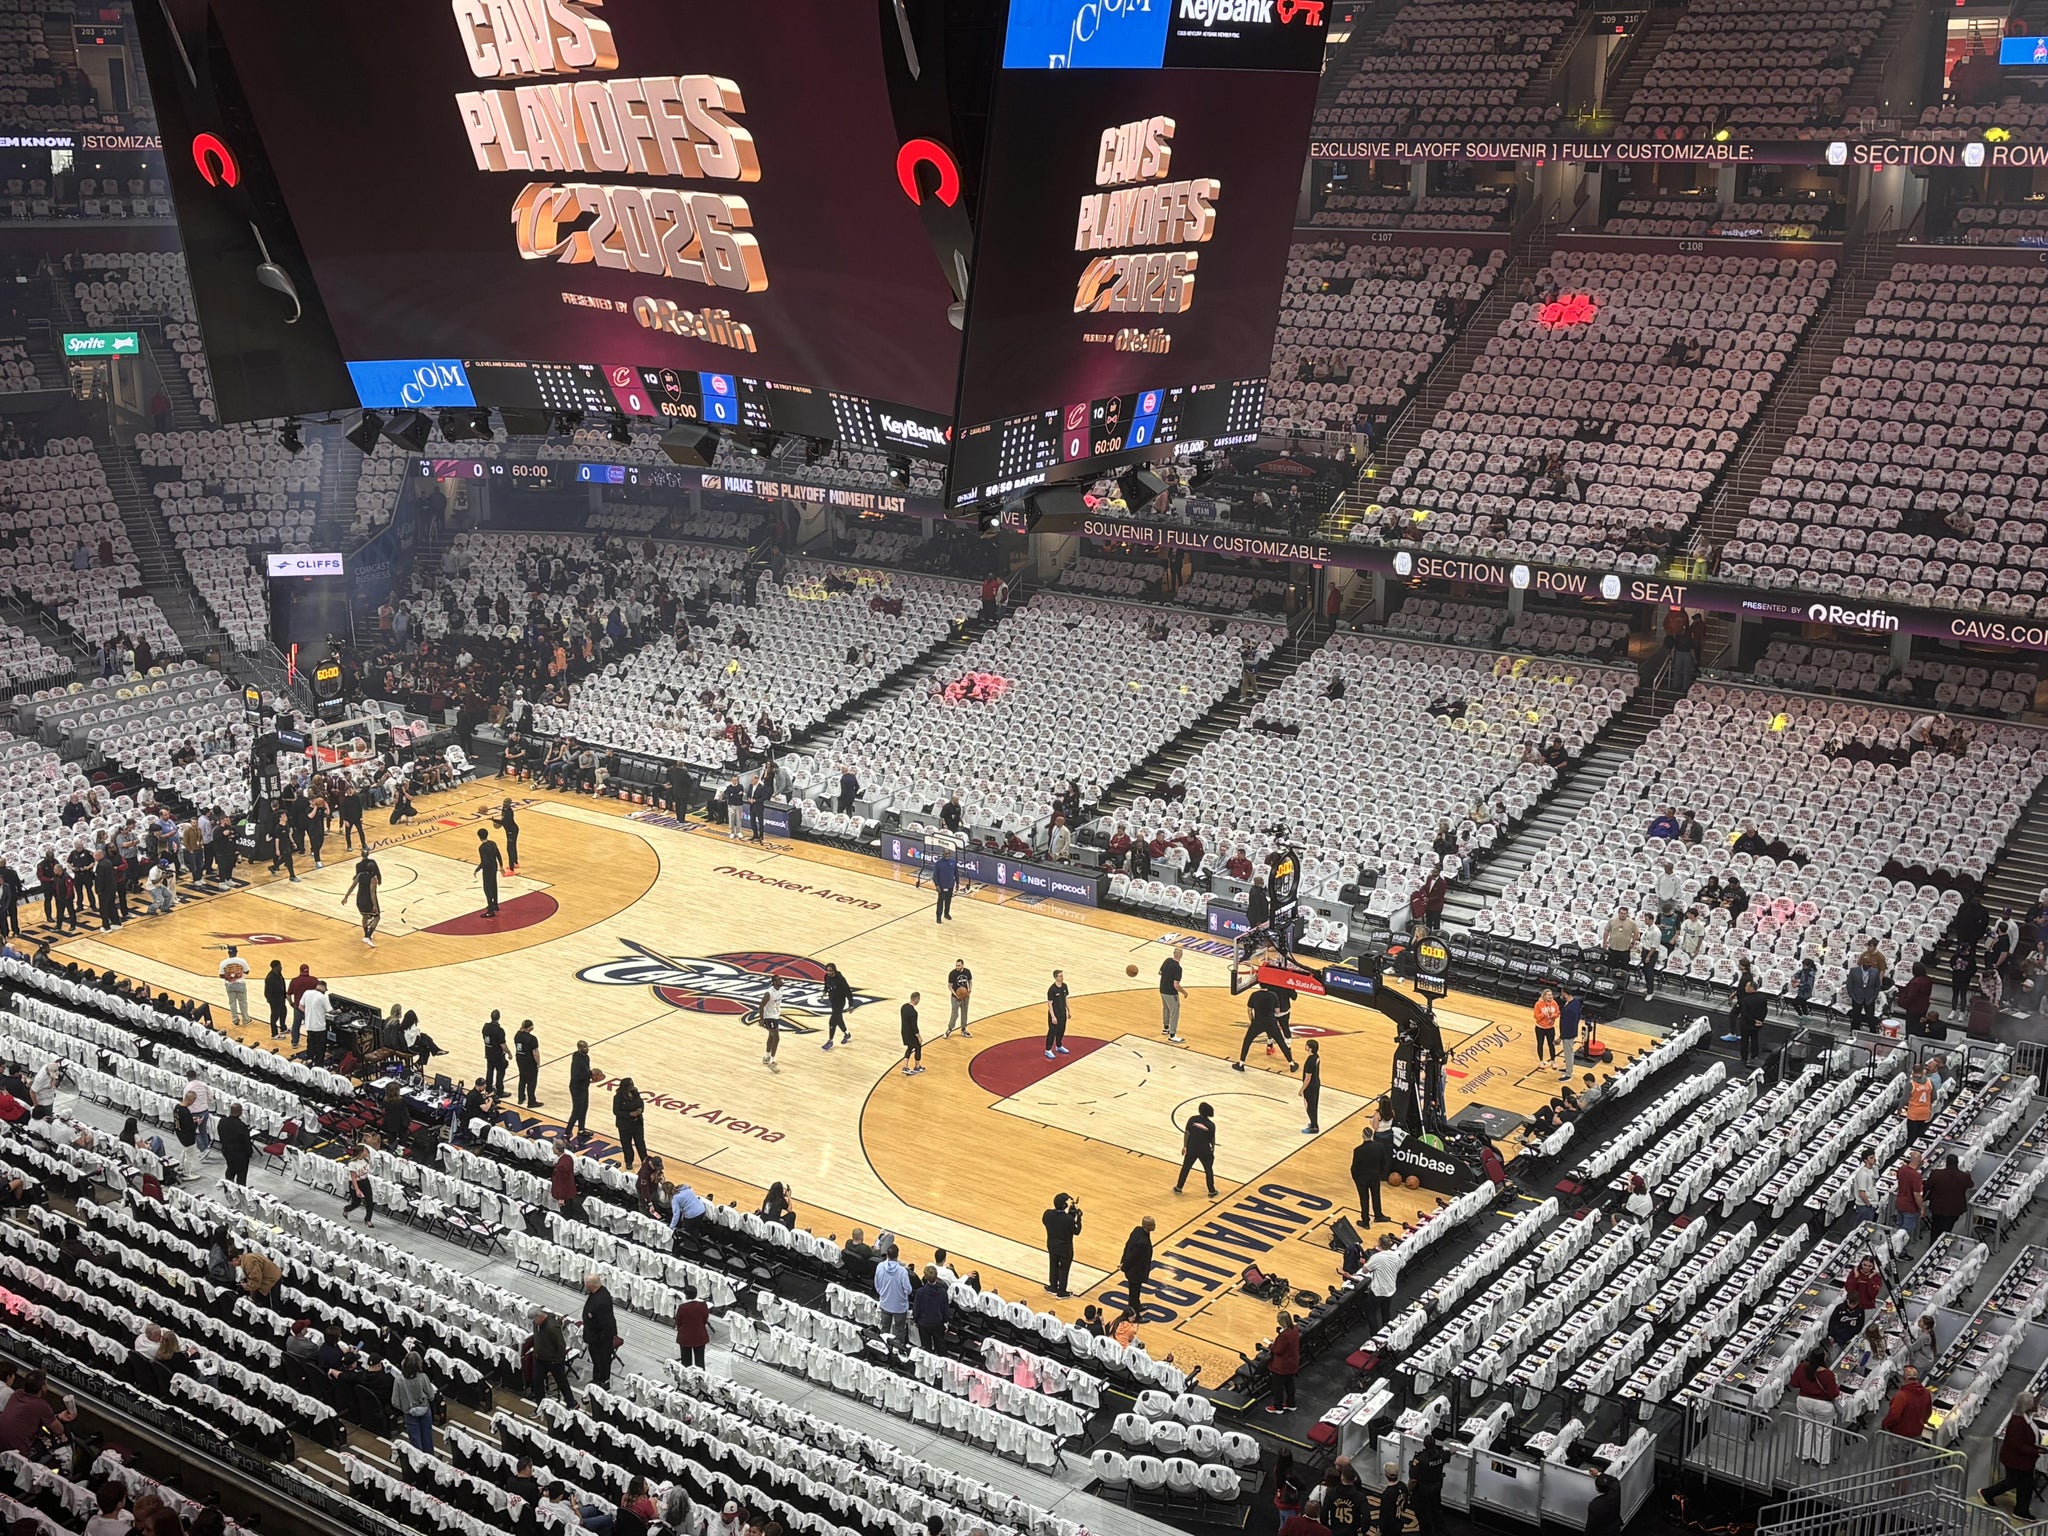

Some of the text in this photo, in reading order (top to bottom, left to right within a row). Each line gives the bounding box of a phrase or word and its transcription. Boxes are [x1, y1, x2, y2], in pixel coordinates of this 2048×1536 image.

[1179, 0, 1274, 27] KeyBank
[1601, 15, 1616, 24] 209
[81, 28, 117, 36] 203 204
[452, 0, 618, 79] CAVS
[455, 74, 761, 182] PLAYOFFS
[21, 137, 75, 148] KNOW.
[1095, 115, 1176, 187] CAVS
[1311, 142, 1390, 158] EXCLUSIVE
[1395, 143, 1461, 158] PLAYOFF
[1465, 142, 1547, 159] SOUVENIR
[1563, 144, 1612, 160] FULLY
[1617, 144, 1753, 161] CUSTOMIZABLE:
[1853, 145, 1954, 165] SECTION
[1993, 145, 2048, 166] ROW
[1075, 178, 1221, 251] PLAYOFFS
[575, 184, 768, 292] 2026
[1109, 251, 1198, 313] 2026
[561, 292, 612, 310] PRESENTED
[68, 337, 105, 351] Sprite
[644, 373, 658, 384] 1Q
[629, 394, 640, 411] 0
[661, 402, 697, 418] 60:00
[714, 402, 725, 420] 0
[1093, 407, 1104, 419] 1Q
[880, 414, 946, 445] KeyBank
[1136, 426, 1145, 444] 0
[1071, 438, 1080, 457] 0
[1094, 437, 1122, 455] 60:00
[473, 464, 548, 478] 0 1Q 60:00
[582, 467, 590, 480] 0
[1014, 473, 1046, 489] RAFFLE
[724, 476, 906, 513] MAKE THIS PLAYOFF MOMENT LAST
[1084, 520, 1154, 542] SOUVENIR
[1167, 530, 1209, 551] FULLY
[1213, 535, 1331, 563] CUSTOMIZABLE:
[297, 559, 340, 569] CLIFFS
[354, 561, 390, 576] COMCAST
[1417, 557, 1504, 584] SECTION
[355, 570, 391, 584] BUSINESS
[1536, 570, 1587, 593] ROW
[1630, 581, 1687, 604] SEAT
[1742, 600, 1899, 631] PRESENTED BY Redfin
[317, 666, 340, 681] 60:00
[733, 869, 882, 911] Rocket Arena
[1027, 874, 1086, 898] NBC peacock
[1420, 945, 1445, 960] 60:00
[597, 1077, 786, 1143] Rcket Arena
[1335, 1507, 1353, 1524] 45
